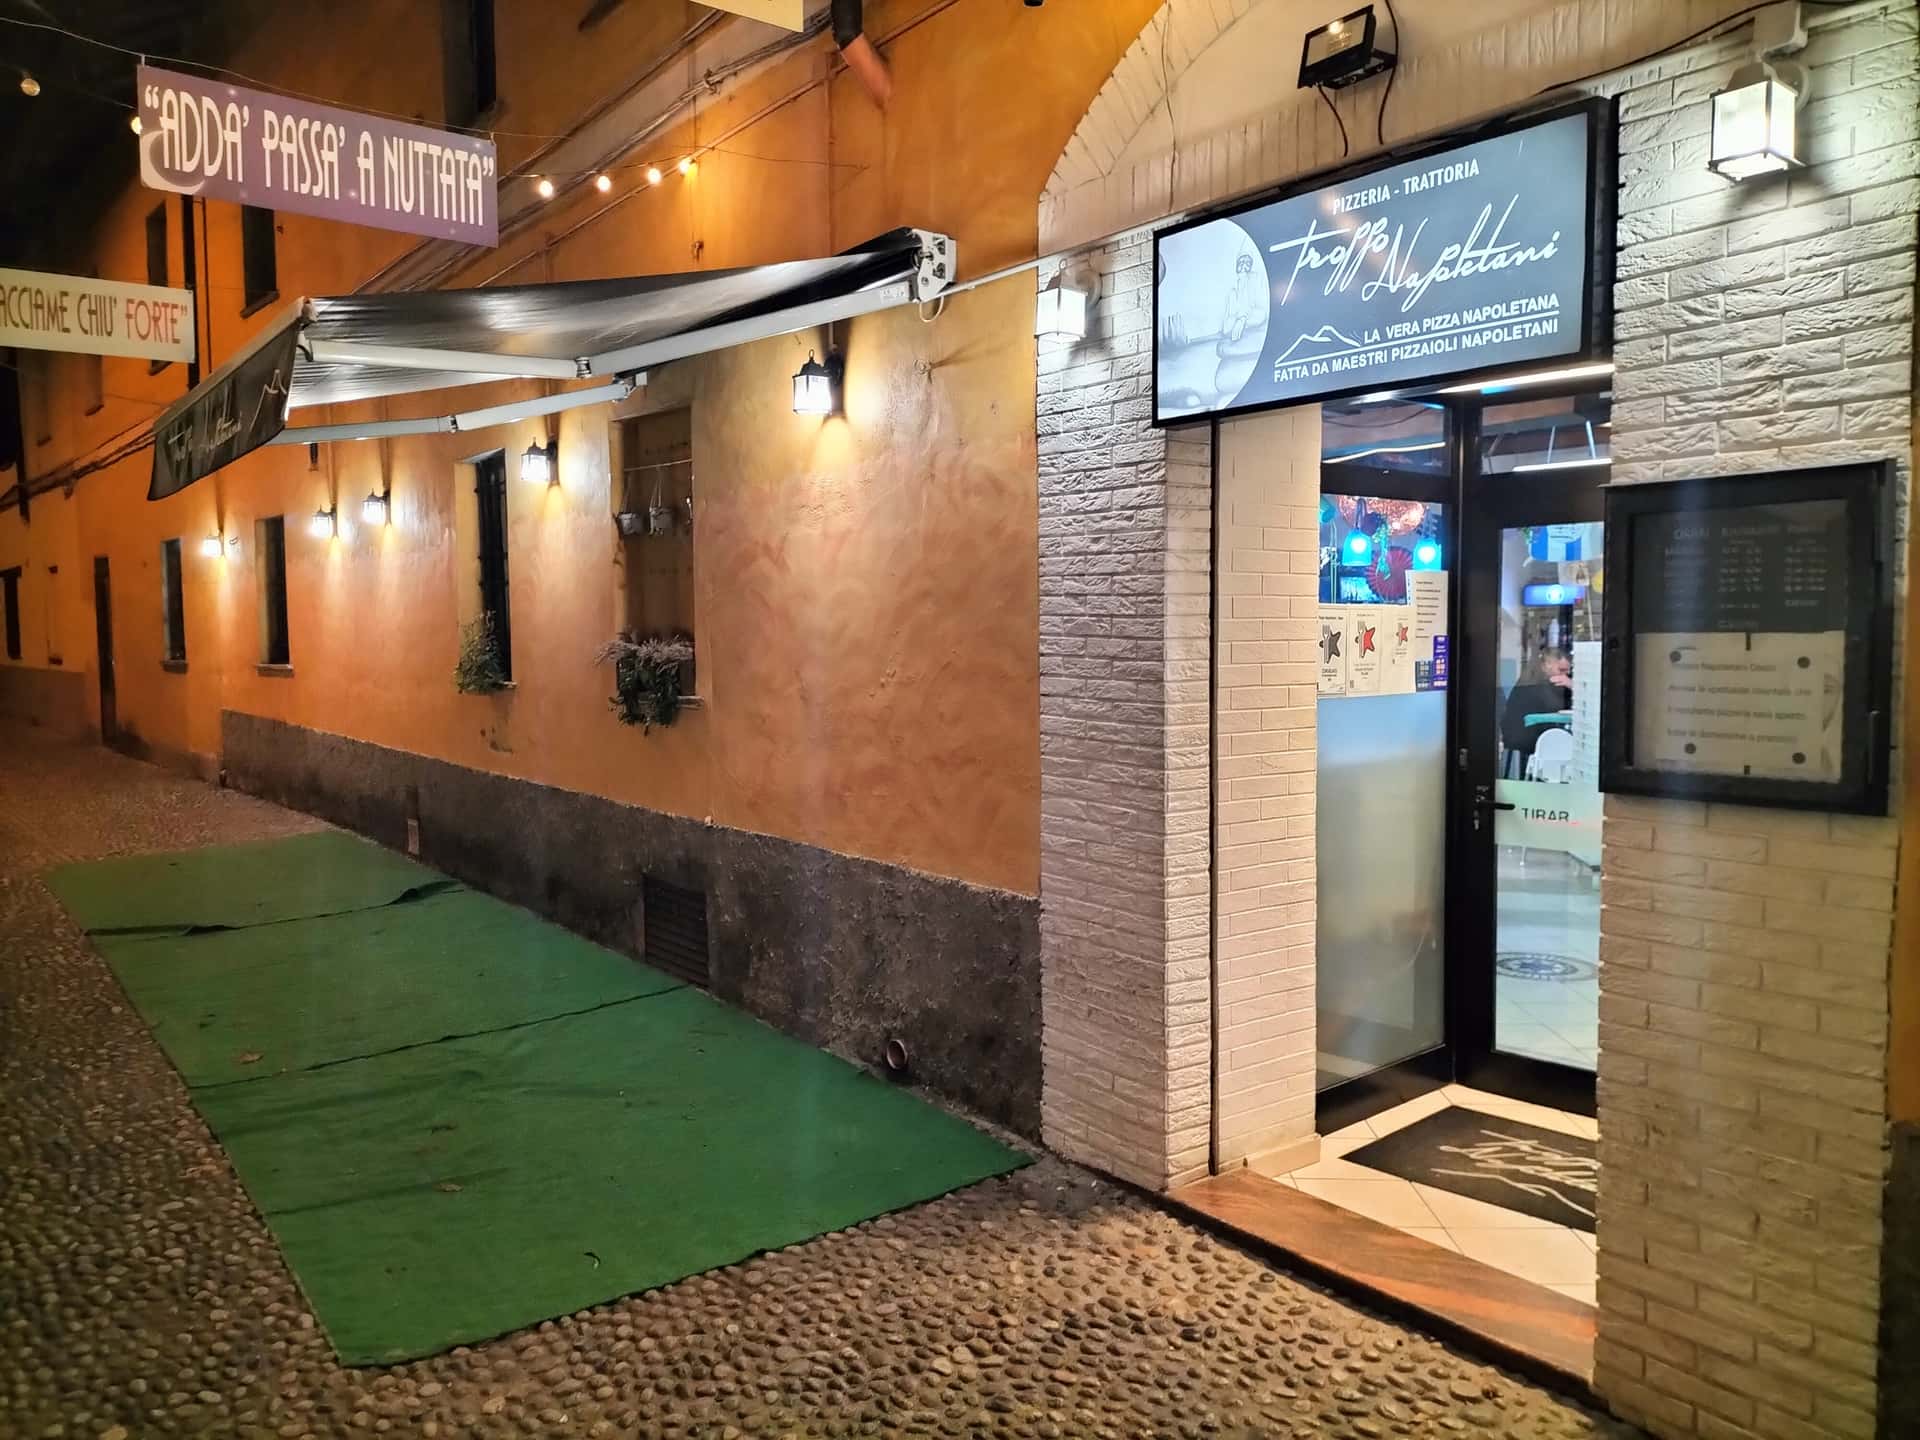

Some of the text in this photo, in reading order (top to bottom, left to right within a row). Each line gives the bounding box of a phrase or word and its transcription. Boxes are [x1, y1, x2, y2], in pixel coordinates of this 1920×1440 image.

[357, 131, 376, 207] A
[1333, 184, 1391, 215] PIZZERIA
[1402, 158, 1480, 195] TRATTORIA
[1269, 217, 1389, 306] Troppo
[1274, 318, 1559, 383] FATTA DA MAESTRI PIZZAIOLI NAPOLETANI
[1364, 293, 1560, 345] LA VERA PIZZA NAPOLETANA
